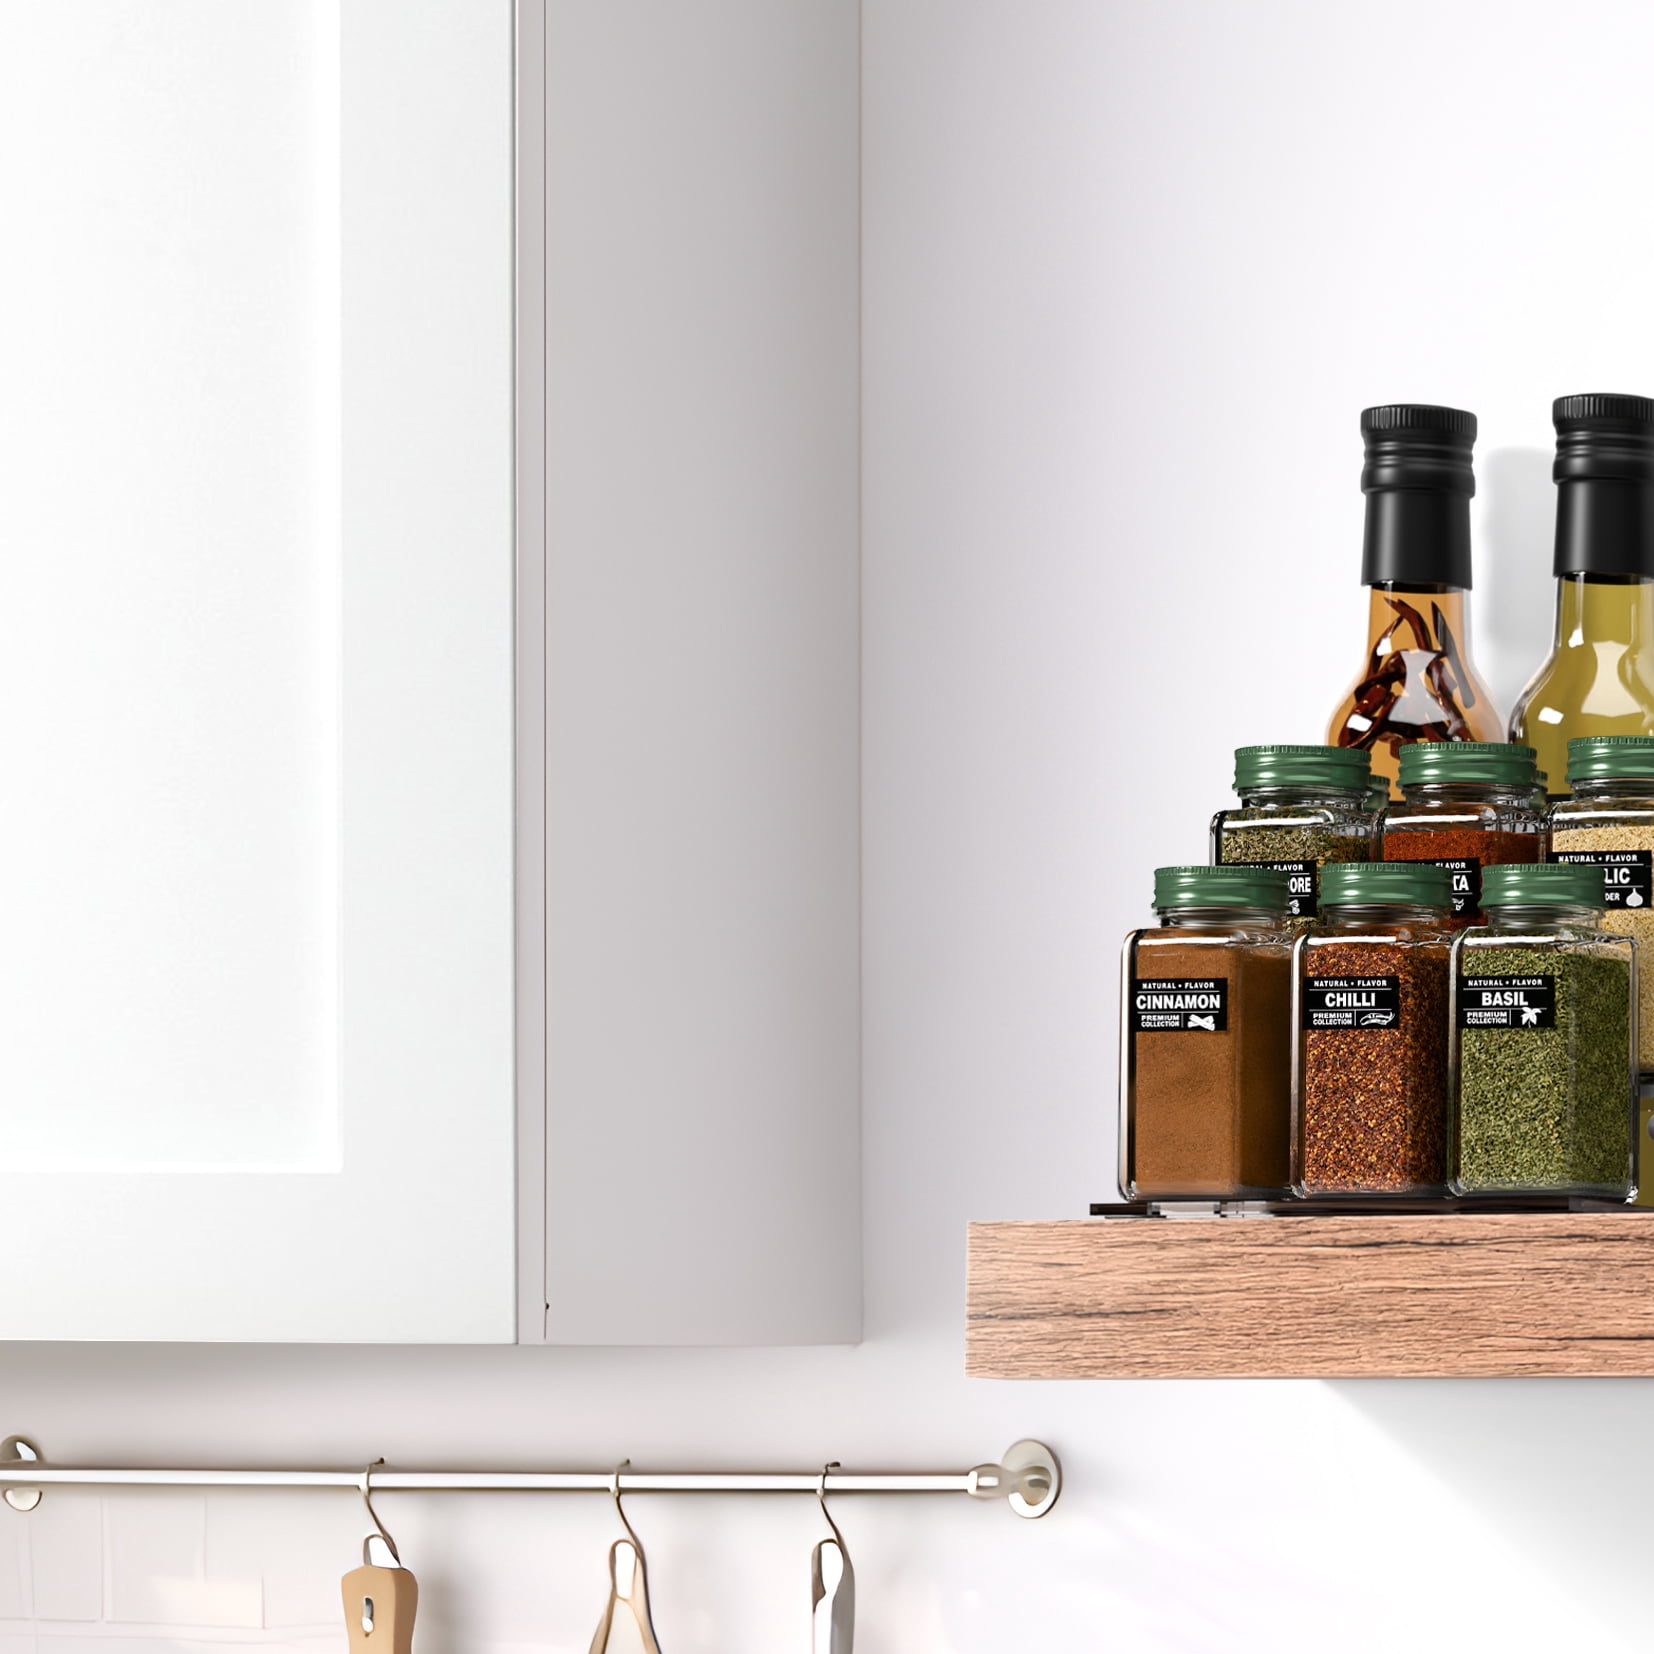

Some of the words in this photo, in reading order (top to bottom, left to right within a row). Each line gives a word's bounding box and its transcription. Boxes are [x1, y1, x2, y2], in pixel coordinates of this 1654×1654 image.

[1558, 854, 1596, 863] NATURAL
[1605, 854, 1638, 862] FLAVOR
[1603, 867, 1631, 884] LIC
[1605, 892, 1620, 901] DER
[1142, 982, 1176, 990] NATURAL
[1184, 982, 1215, 990] FLAVOR
[1314, 980, 1348, 988] NATURAL
[1357, 979, 1387, 987] FLAVOR
[1468, 979, 1504, 987] NATURAL
[1512, 978, 1543, 986] FLAVOR
[1136, 994, 1221, 1010] CINNAMON
[1325, 992, 1376, 1008] CHILLI
[1481, 991, 1529, 1007] BASIL
[1313, 1018, 1353, 1026] COLLECTION
[1467, 1017, 1508, 1025] COLLECTION
